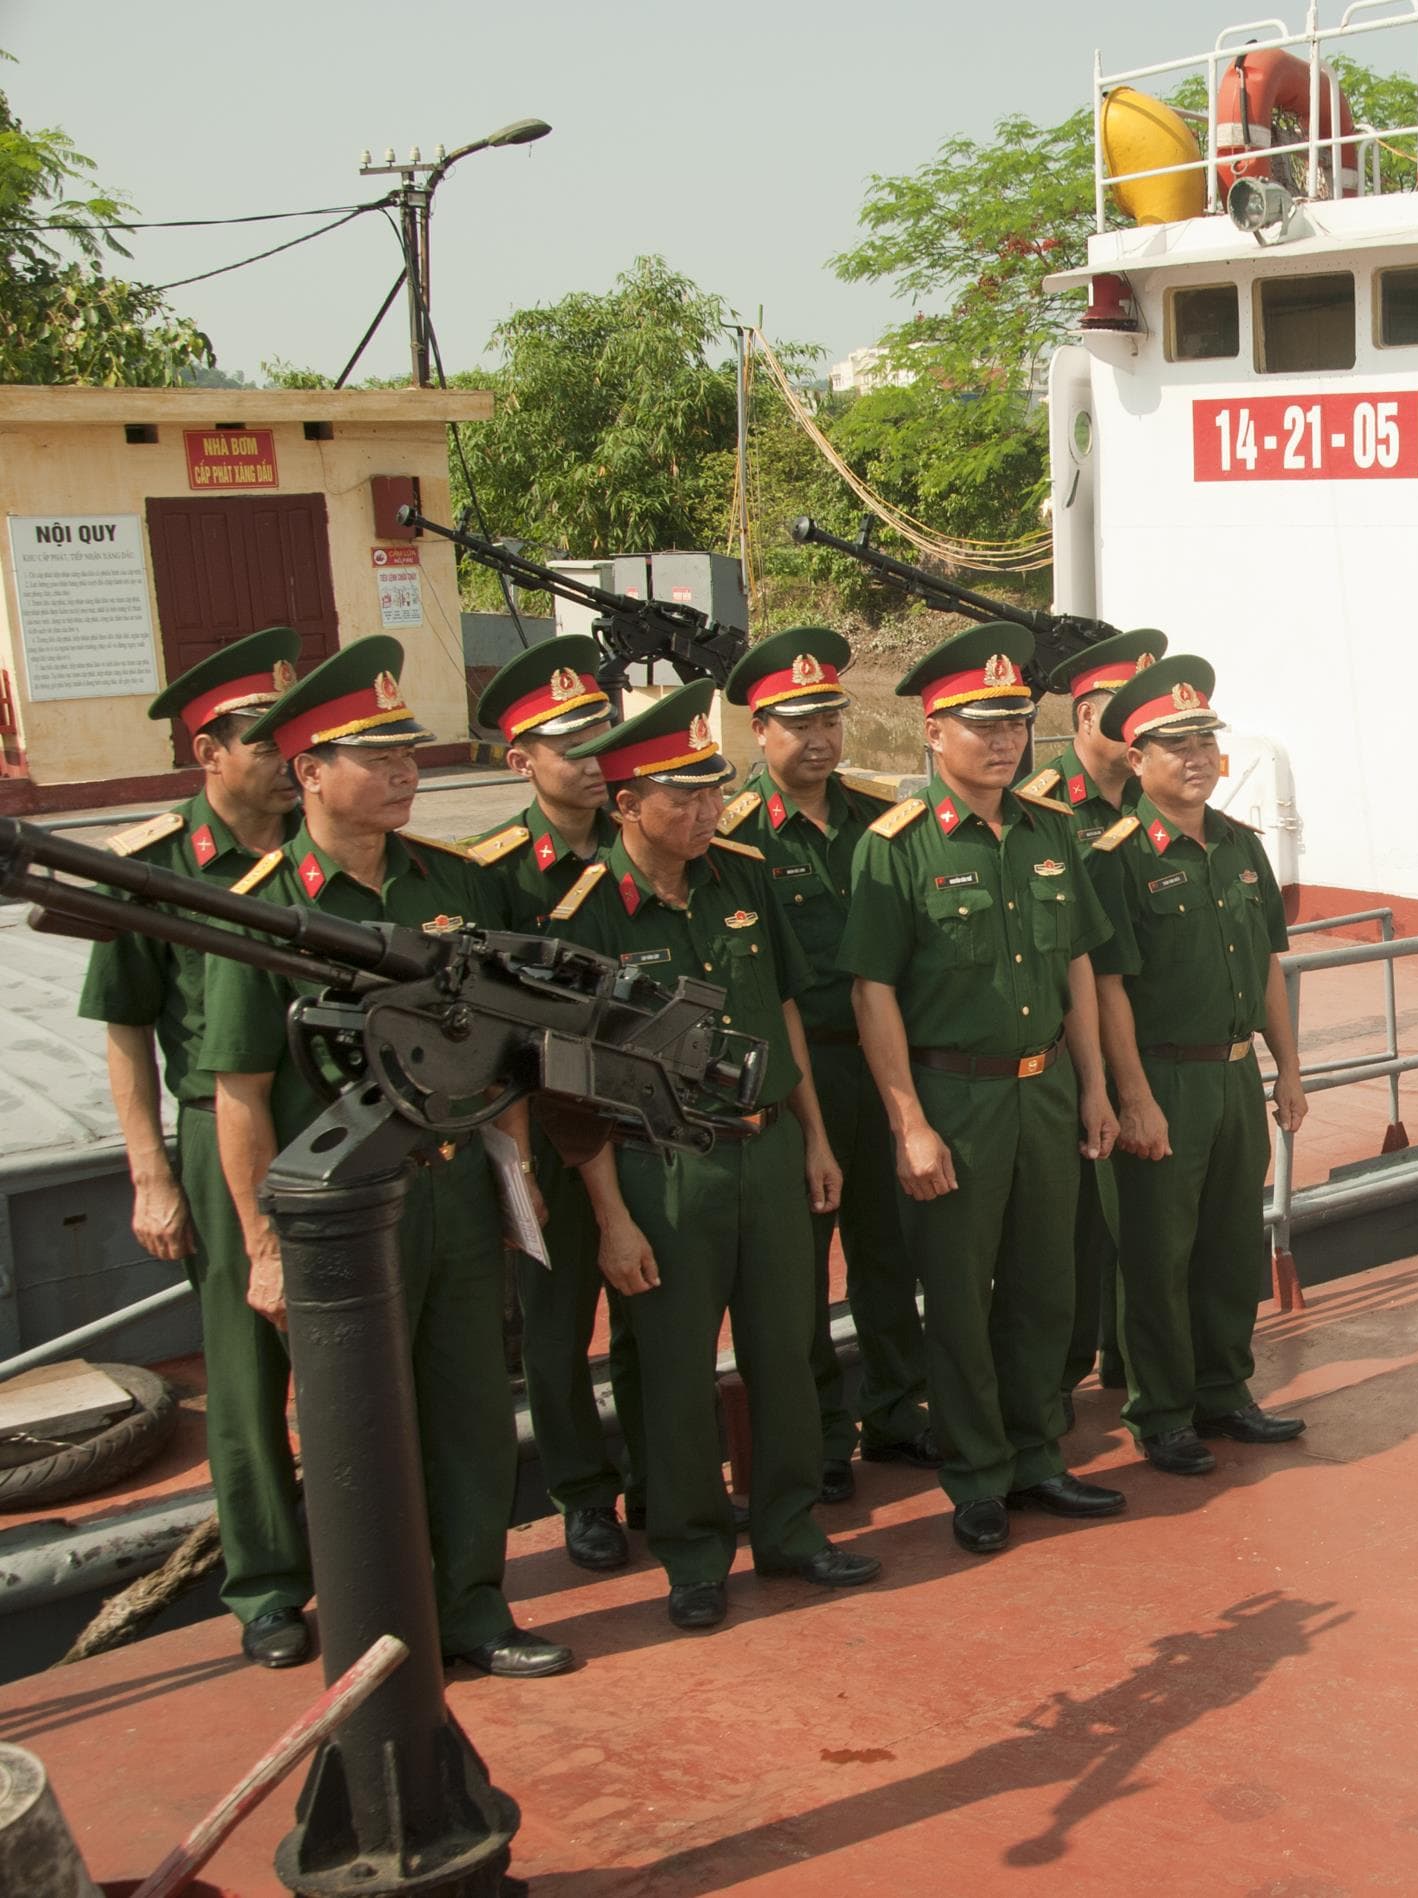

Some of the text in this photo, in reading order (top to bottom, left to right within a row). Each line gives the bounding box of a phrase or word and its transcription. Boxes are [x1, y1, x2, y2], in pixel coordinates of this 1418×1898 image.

[203, 434, 258, 456] NHÀ BƠM
[1215, 401, 1400, 471] 14-21-05
[211, 461, 233, 483] PHÁT
[35, 522, 117, 547] NỘI QUY
